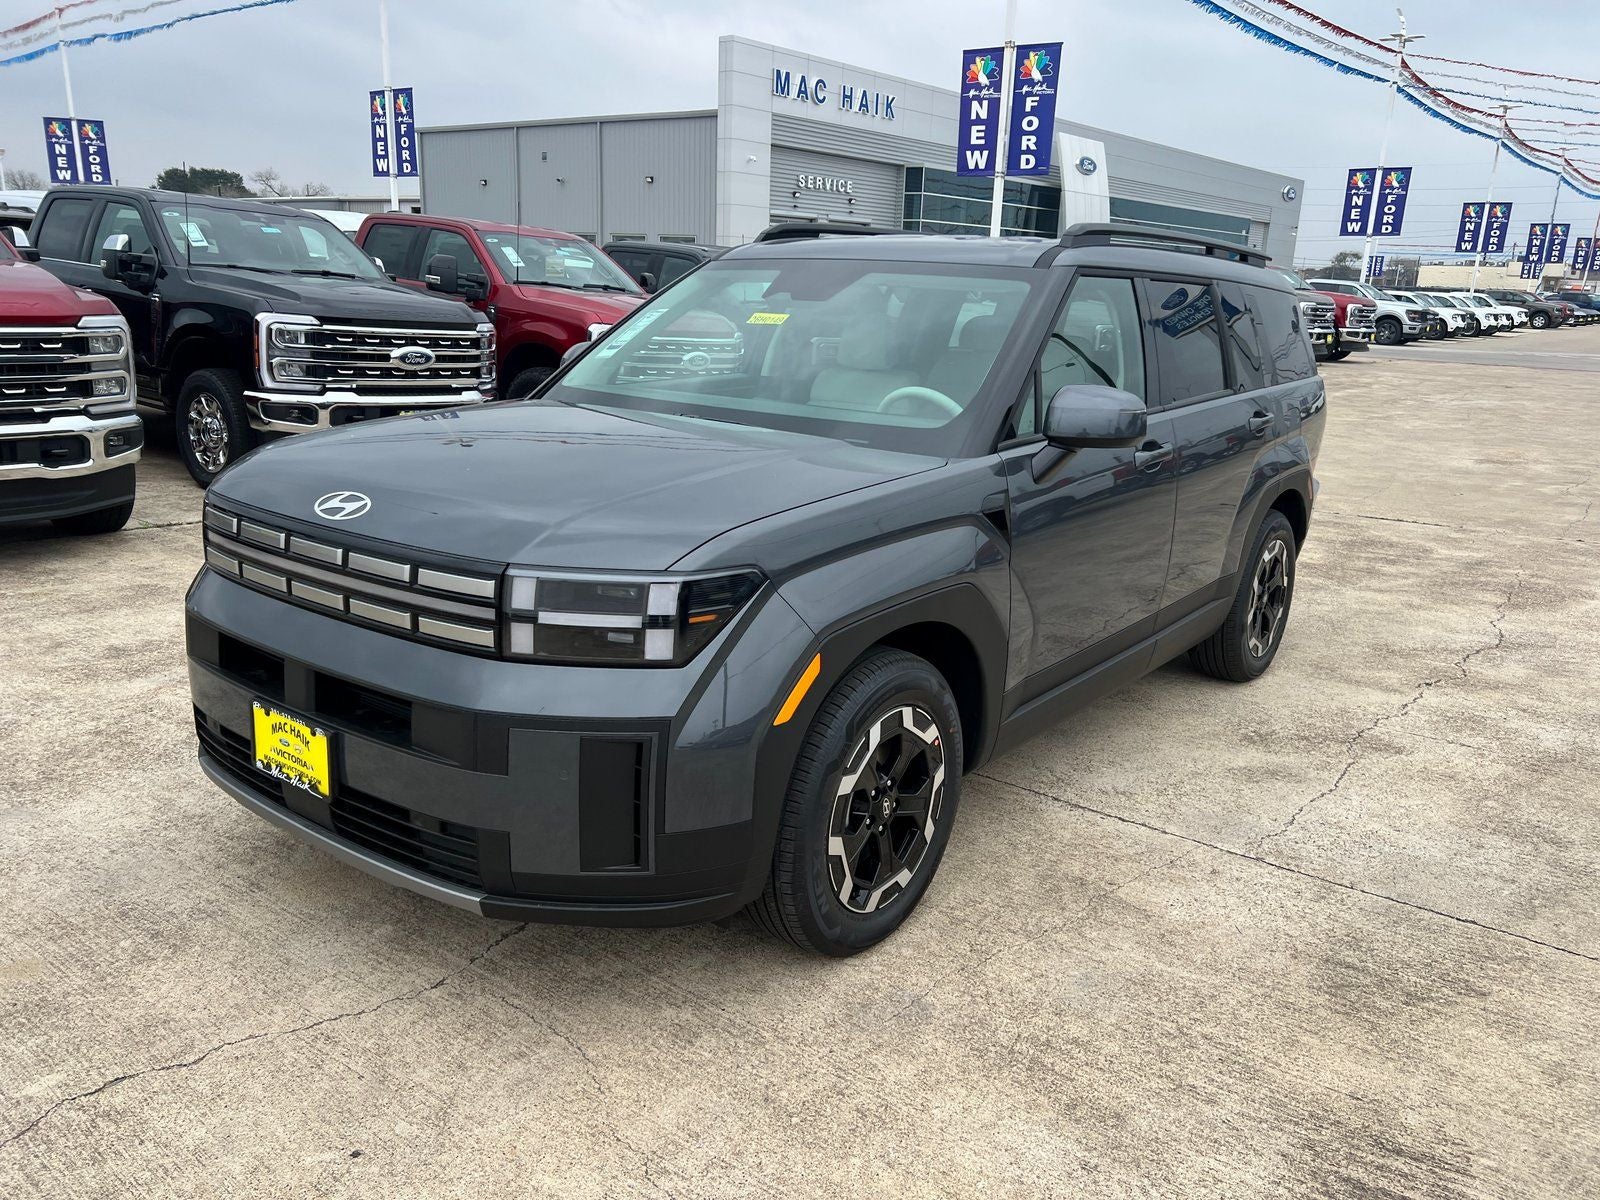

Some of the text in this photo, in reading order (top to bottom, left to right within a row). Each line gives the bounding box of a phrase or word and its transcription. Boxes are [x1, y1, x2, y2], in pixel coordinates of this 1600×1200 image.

[773, 66, 896, 120] MAC HAIK
[375, 124, 388, 172] NEW
[400, 124, 412, 173] FORD
[966, 100, 989, 170] NEW
[1020, 96, 1040, 170] FORD
[54, 143, 72, 181] NEW
[88, 145, 103, 182] FORD
[799, 174, 854, 193] SERVICE
[1346, 195, 1363, 233] NEW
[1381, 194, 1397, 234] FORD
[1461, 222, 1475, 250] NEW
[1488, 222, 1501, 251] FORD
[1529, 238, 1541, 261] NEW
[1550, 239, 1562, 262] FORD
[1575, 250, 1585, 269] NEW
[405, 352, 426, 364] Ford
[271, 721, 288, 735] MAC
[289, 725, 311, 752] HAIK
[275, 747, 309, 770] VICTORIA
